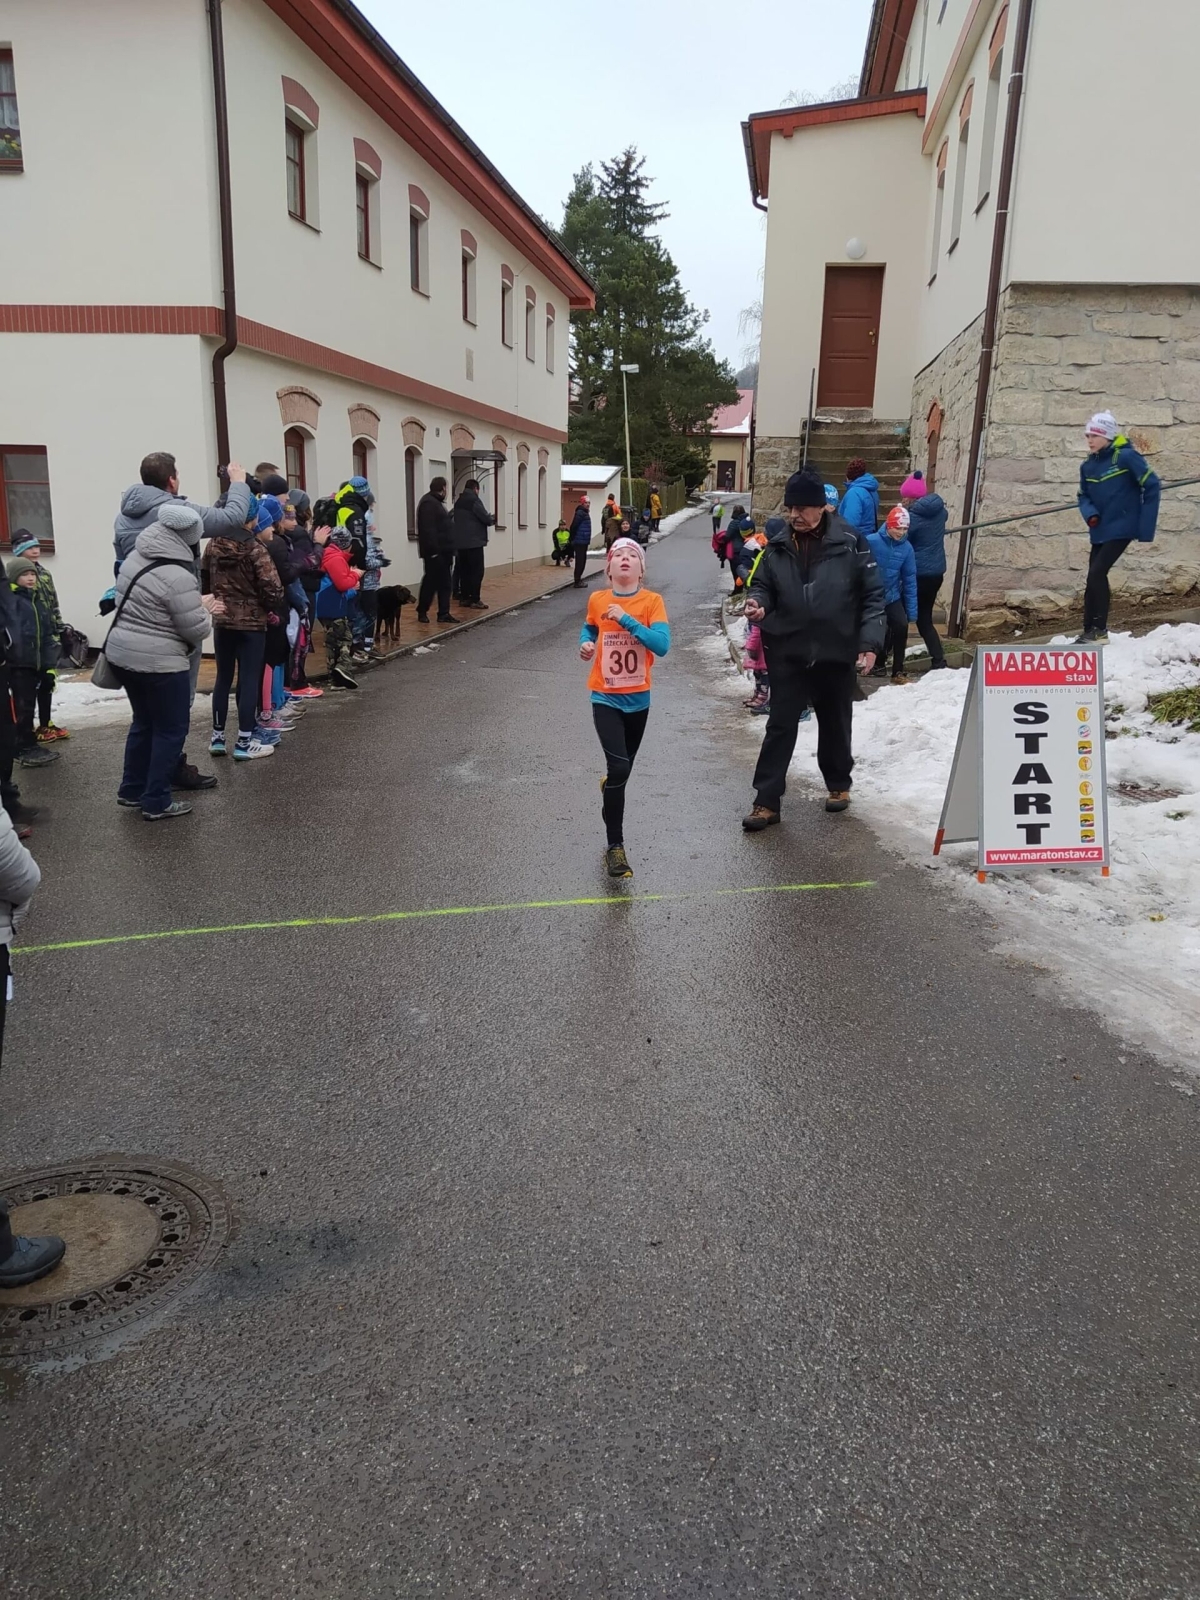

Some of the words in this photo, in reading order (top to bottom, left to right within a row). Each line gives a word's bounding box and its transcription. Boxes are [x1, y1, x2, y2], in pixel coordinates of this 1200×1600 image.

[609, 649, 638, 676] 30
[985, 652, 1096, 672] MARATON
[1065, 673, 1094, 682] stav
[1011, 701, 1053, 845] START
[990, 850, 1100, 862] www.maratonstav.cz
